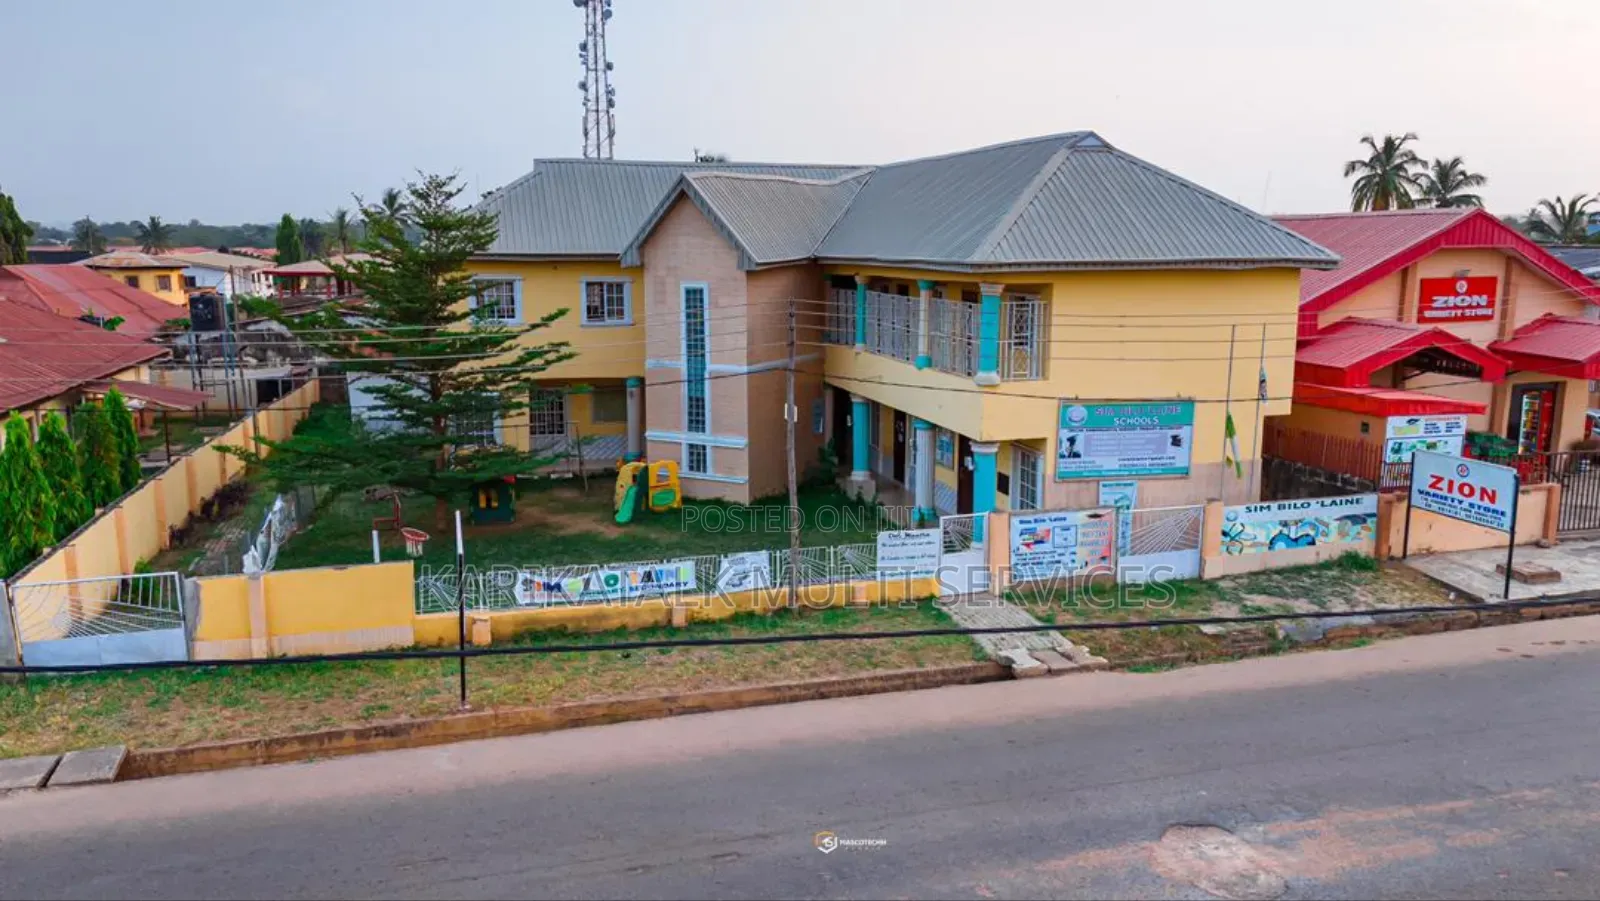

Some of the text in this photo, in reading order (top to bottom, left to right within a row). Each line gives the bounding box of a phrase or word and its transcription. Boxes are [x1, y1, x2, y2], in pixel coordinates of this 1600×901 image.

[1431, 295, 1488, 308] ZION
[1113, 416, 1159, 426] SCHOOLS
[1428, 474, 1497, 505] ZION
[1245, 505, 1272, 514] SIM
[1277, 502, 1312, 511] BILO
[1417, 488, 1464, 505] VARIETY
[1468, 502, 1506, 517] STORE
